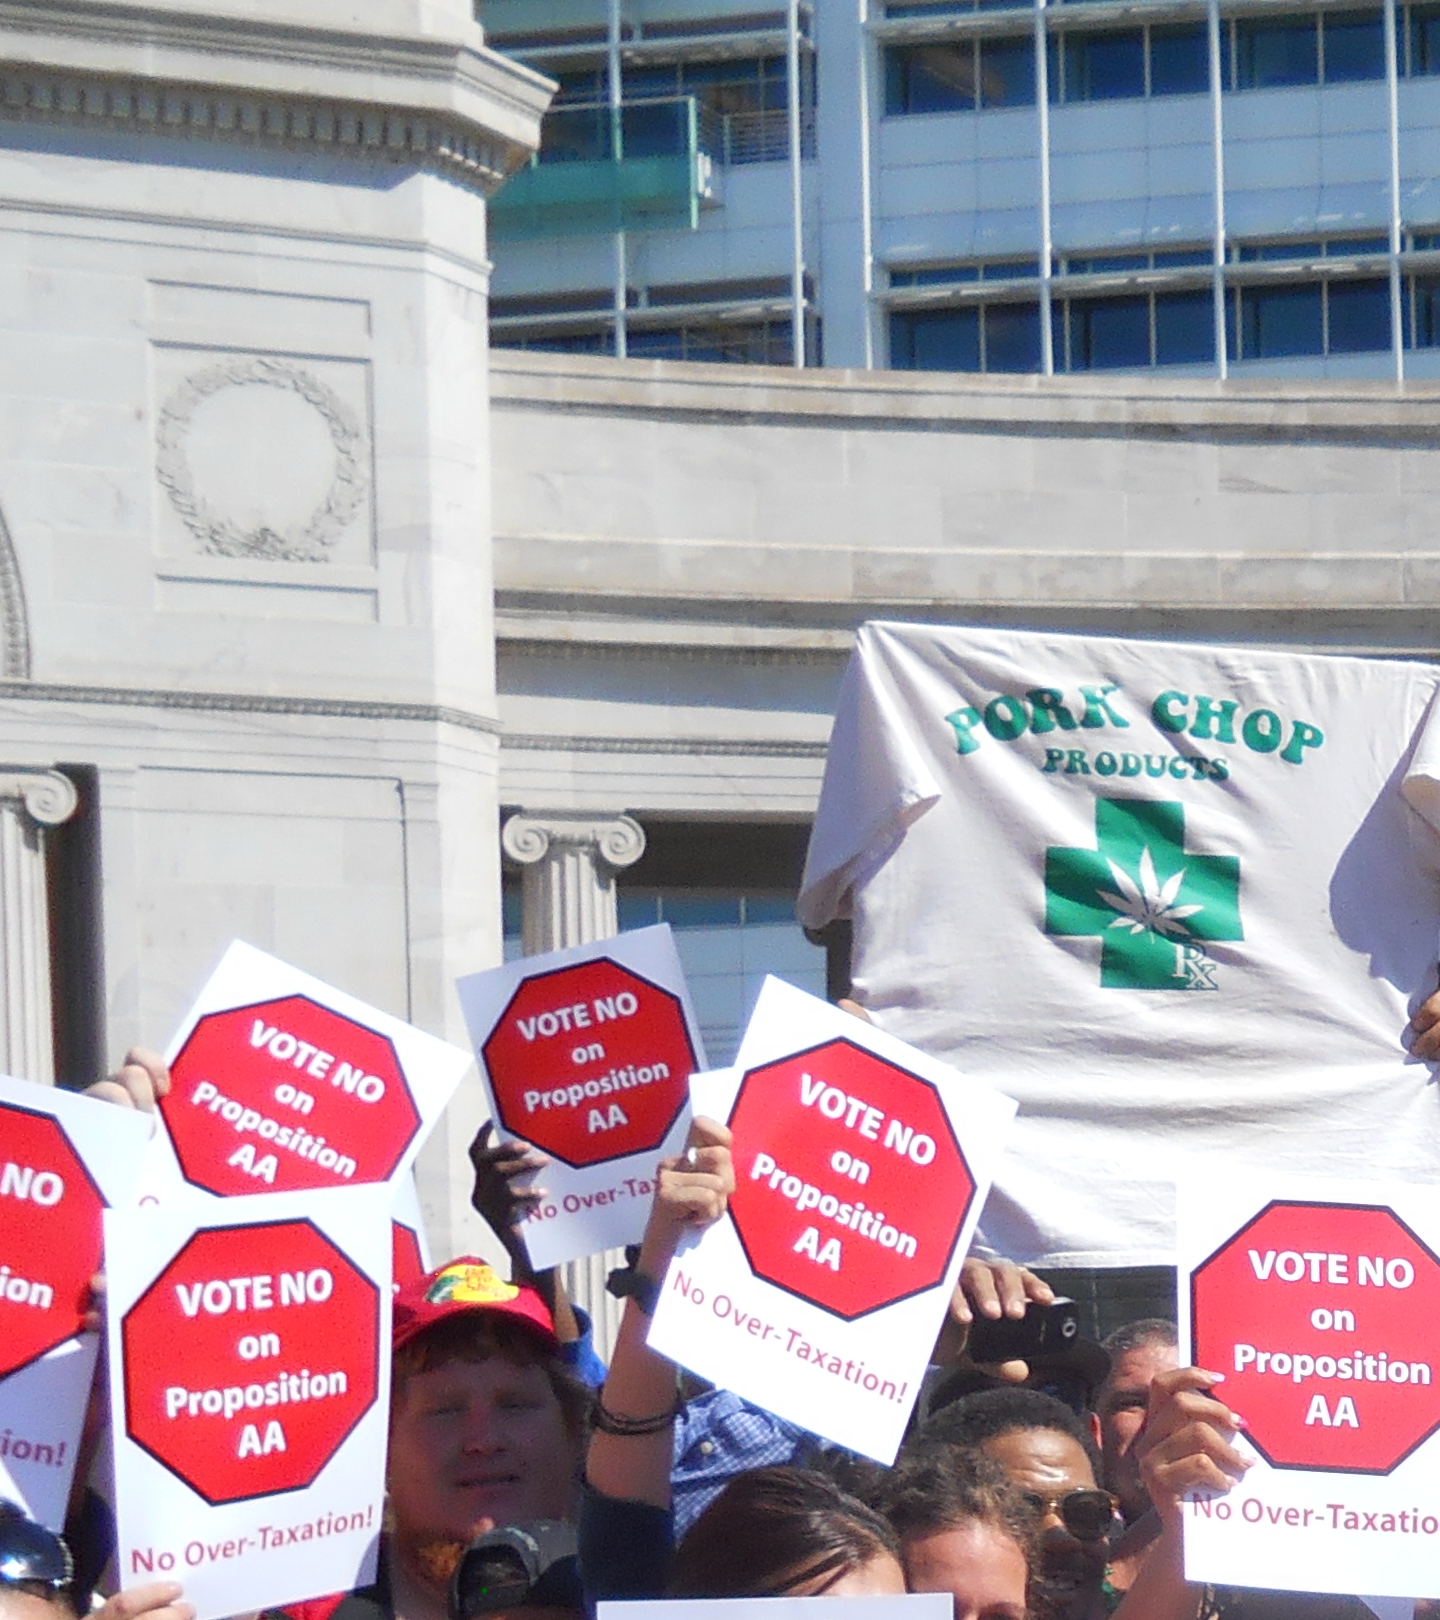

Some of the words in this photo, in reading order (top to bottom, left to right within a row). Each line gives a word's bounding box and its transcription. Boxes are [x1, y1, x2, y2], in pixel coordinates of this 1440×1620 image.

[944, 681, 1131, 755] PORK
[1151, 690, 1325, 765] CHOP
[1042, 747, 1229, 782] PRODUCTS
[517, 1006, 589, 1042] VOTE
[594, 992, 639, 1024] NO
[248, 1018, 334, 1082] VOTE
[328, 1064, 386, 1104] NO
[572, 1037, 605, 1063] on
[274, 1082, 315, 1113] on
[524, 1061, 670, 1113] Proposition
[191, 1080, 357, 1179] Proposition
[587, 1104, 628, 1134] AA
[799, 1073, 880, 1142] VOTE
[885, 1119, 936, 1166] NO
[0, 1162, 64, 1206] NO
[228, 1144, 279, 1183] AA
[830, 1151, 870, 1184] on
[526, 1201, 558, 1224] No
[562, 1176, 661, 1215] Over-Tax
[751, 1153, 918, 1258] Proposition
[792, 1226, 843, 1271] AA
[1248, 1250, 1349, 1285] VOTE
[1357, 1256, 1414, 1289] NO
[176, 1277, 272, 1318] VOTE
[280, 1269, 333, 1303] NO
[673, 1271, 705, 1305] No
[711, 1294, 909, 1404] Over-Taxation!
[1311, 1309, 1355, 1332] on
[238, 1331, 279, 1362] on
[1234, 1344, 1431, 1385] Proposition
[166, 1370, 347, 1419] Proposition
[1305, 1395, 1359, 1428] AA
[237, 1425, 286, 1458] AA
[1193, 1493, 1232, 1520] No
[129, 1547, 176, 1574] No
[184, 1507, 374, 1568] Over-Taxation!
